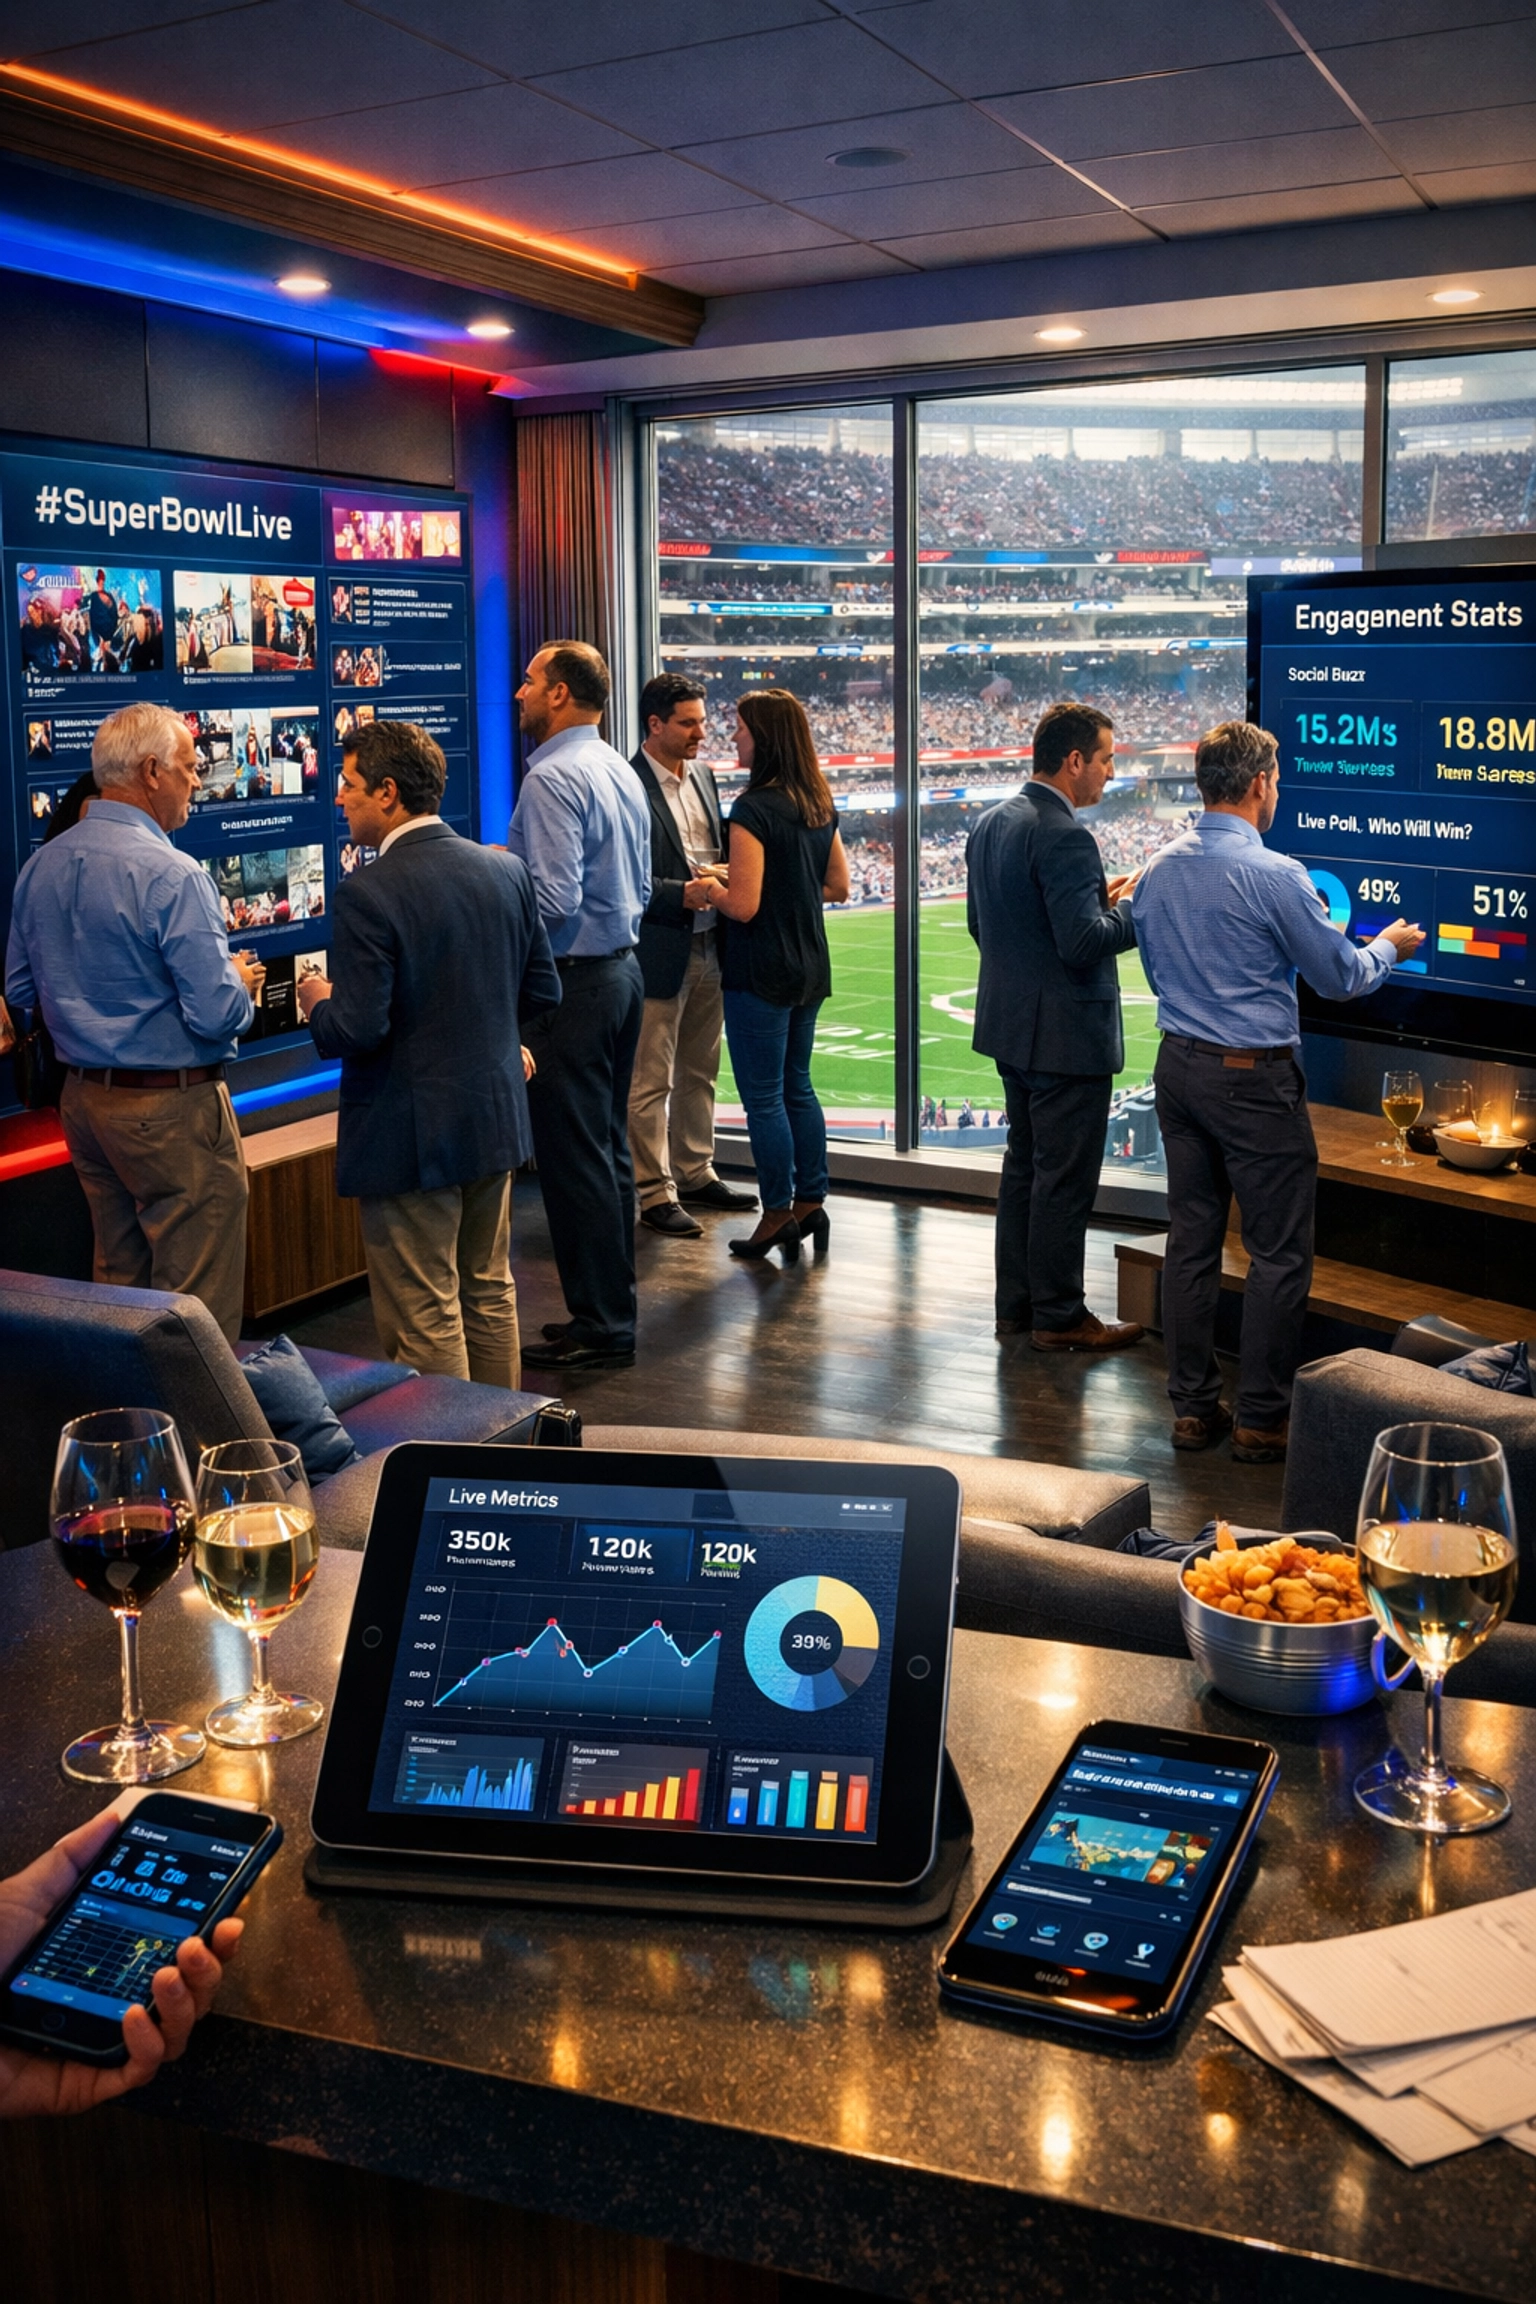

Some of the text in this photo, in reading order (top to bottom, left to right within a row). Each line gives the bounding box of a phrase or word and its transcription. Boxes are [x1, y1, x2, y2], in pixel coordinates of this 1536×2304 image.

[34, 485, 292, 540] #SuperBowlLive
[1450, 599, 1523, 628] Stats
[1288, 666, 1329, 682] Social
[1296, 713, 1398, 747] 15.2Ms
[1439, 716, 1536, 752] 18.8M
[1297, 812, 1327, 830] Live
[1367, 817, 1402, 836] Who
[1403, 819, 1431, 838] Will
[1433, 821, 1473, 840] Win?
[1357, 877, 1401, 905] 49%
[1473, 884, 1528, 919] 51%
[448, 1487, 559, 1508] Live Metrics
[448, 1529, 512, 1552] 350k
[589, 1536, 653, 1560] 120k
[701, 1542, 757, 1565] 120k
